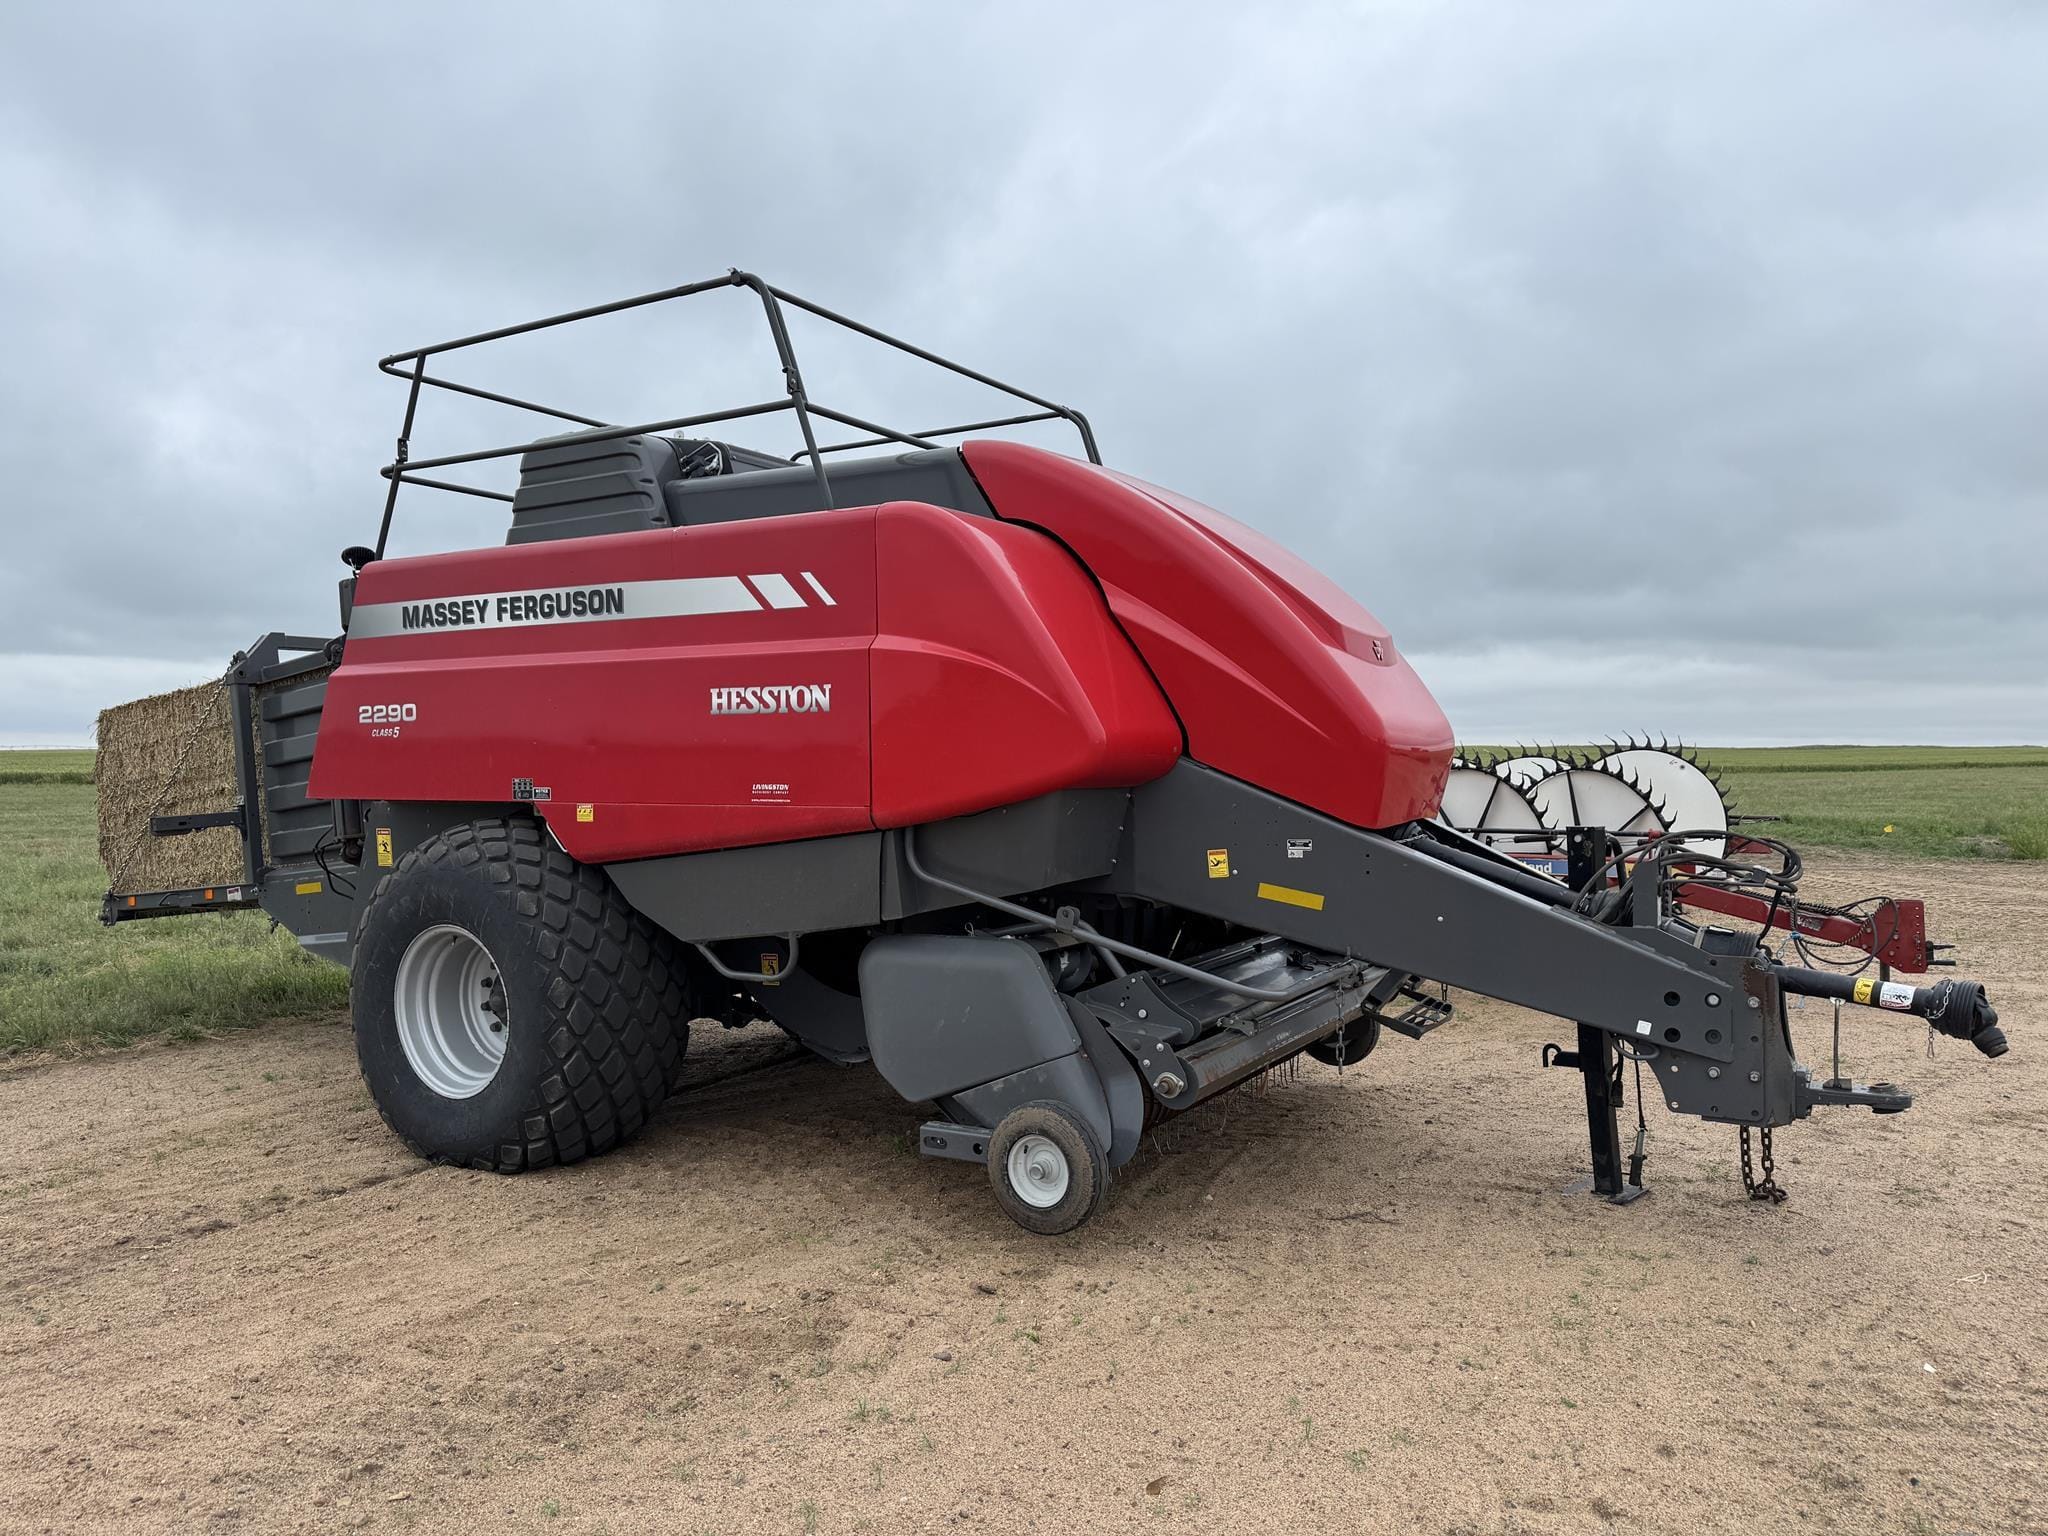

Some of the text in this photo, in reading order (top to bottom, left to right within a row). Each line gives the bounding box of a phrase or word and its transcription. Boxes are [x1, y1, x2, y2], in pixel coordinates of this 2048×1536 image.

[402, 588, 625, 629] MASSEY FERGUSON
[359, 703, 417, 723] 2290
[710, 684, 832, 715] HESSTON
